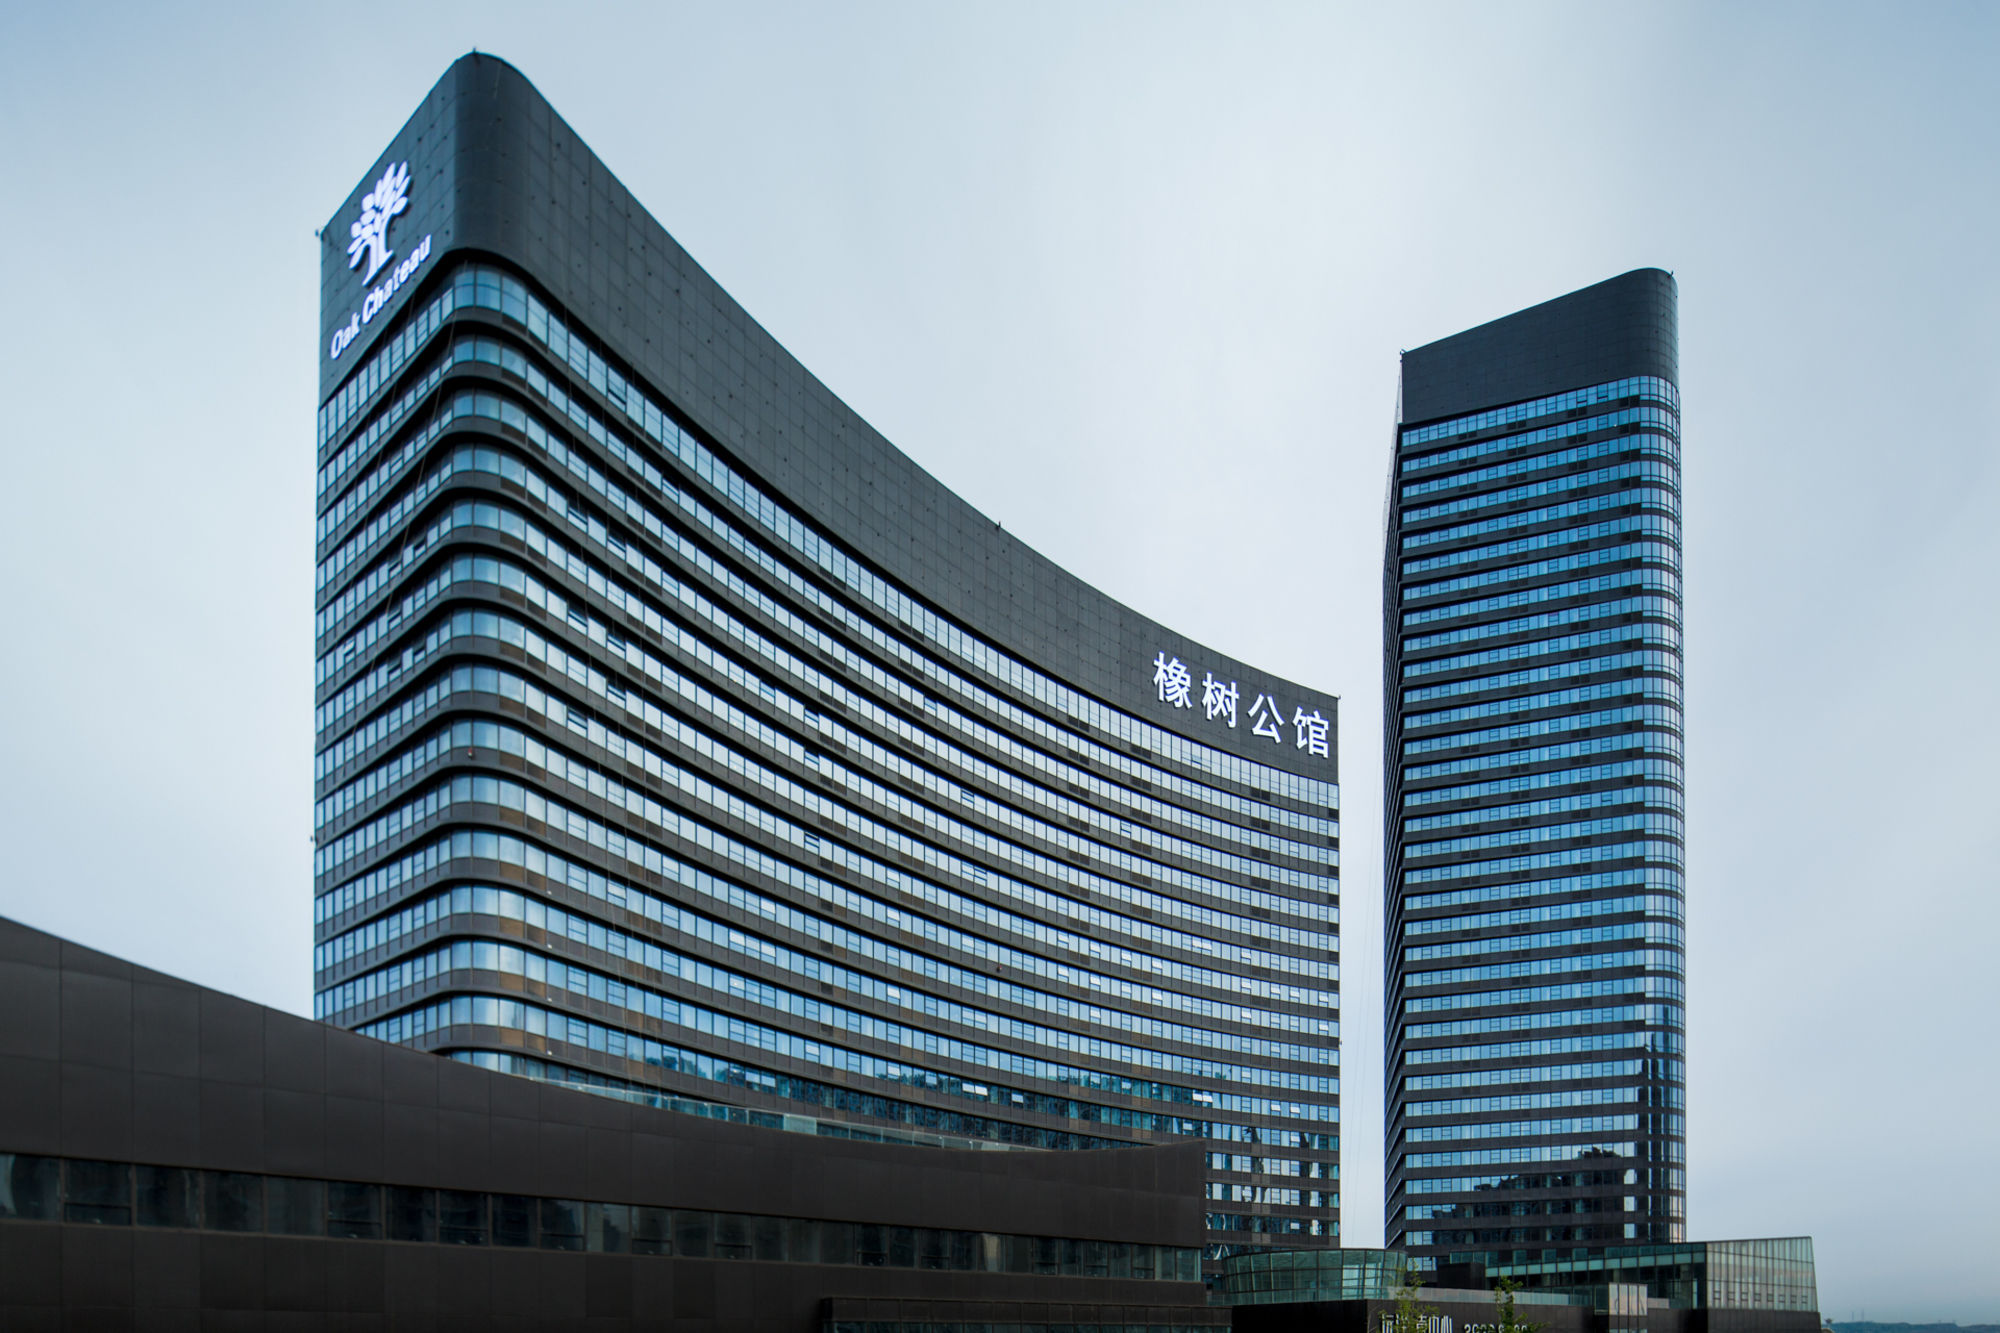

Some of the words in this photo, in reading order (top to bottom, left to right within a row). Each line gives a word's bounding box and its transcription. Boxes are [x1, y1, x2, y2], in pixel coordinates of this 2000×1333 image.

[331, 312, 360, 360] Oak
[362, 234, 432, 324] Chateau
[1153, 651, 1329, 759] 橡树公馆
